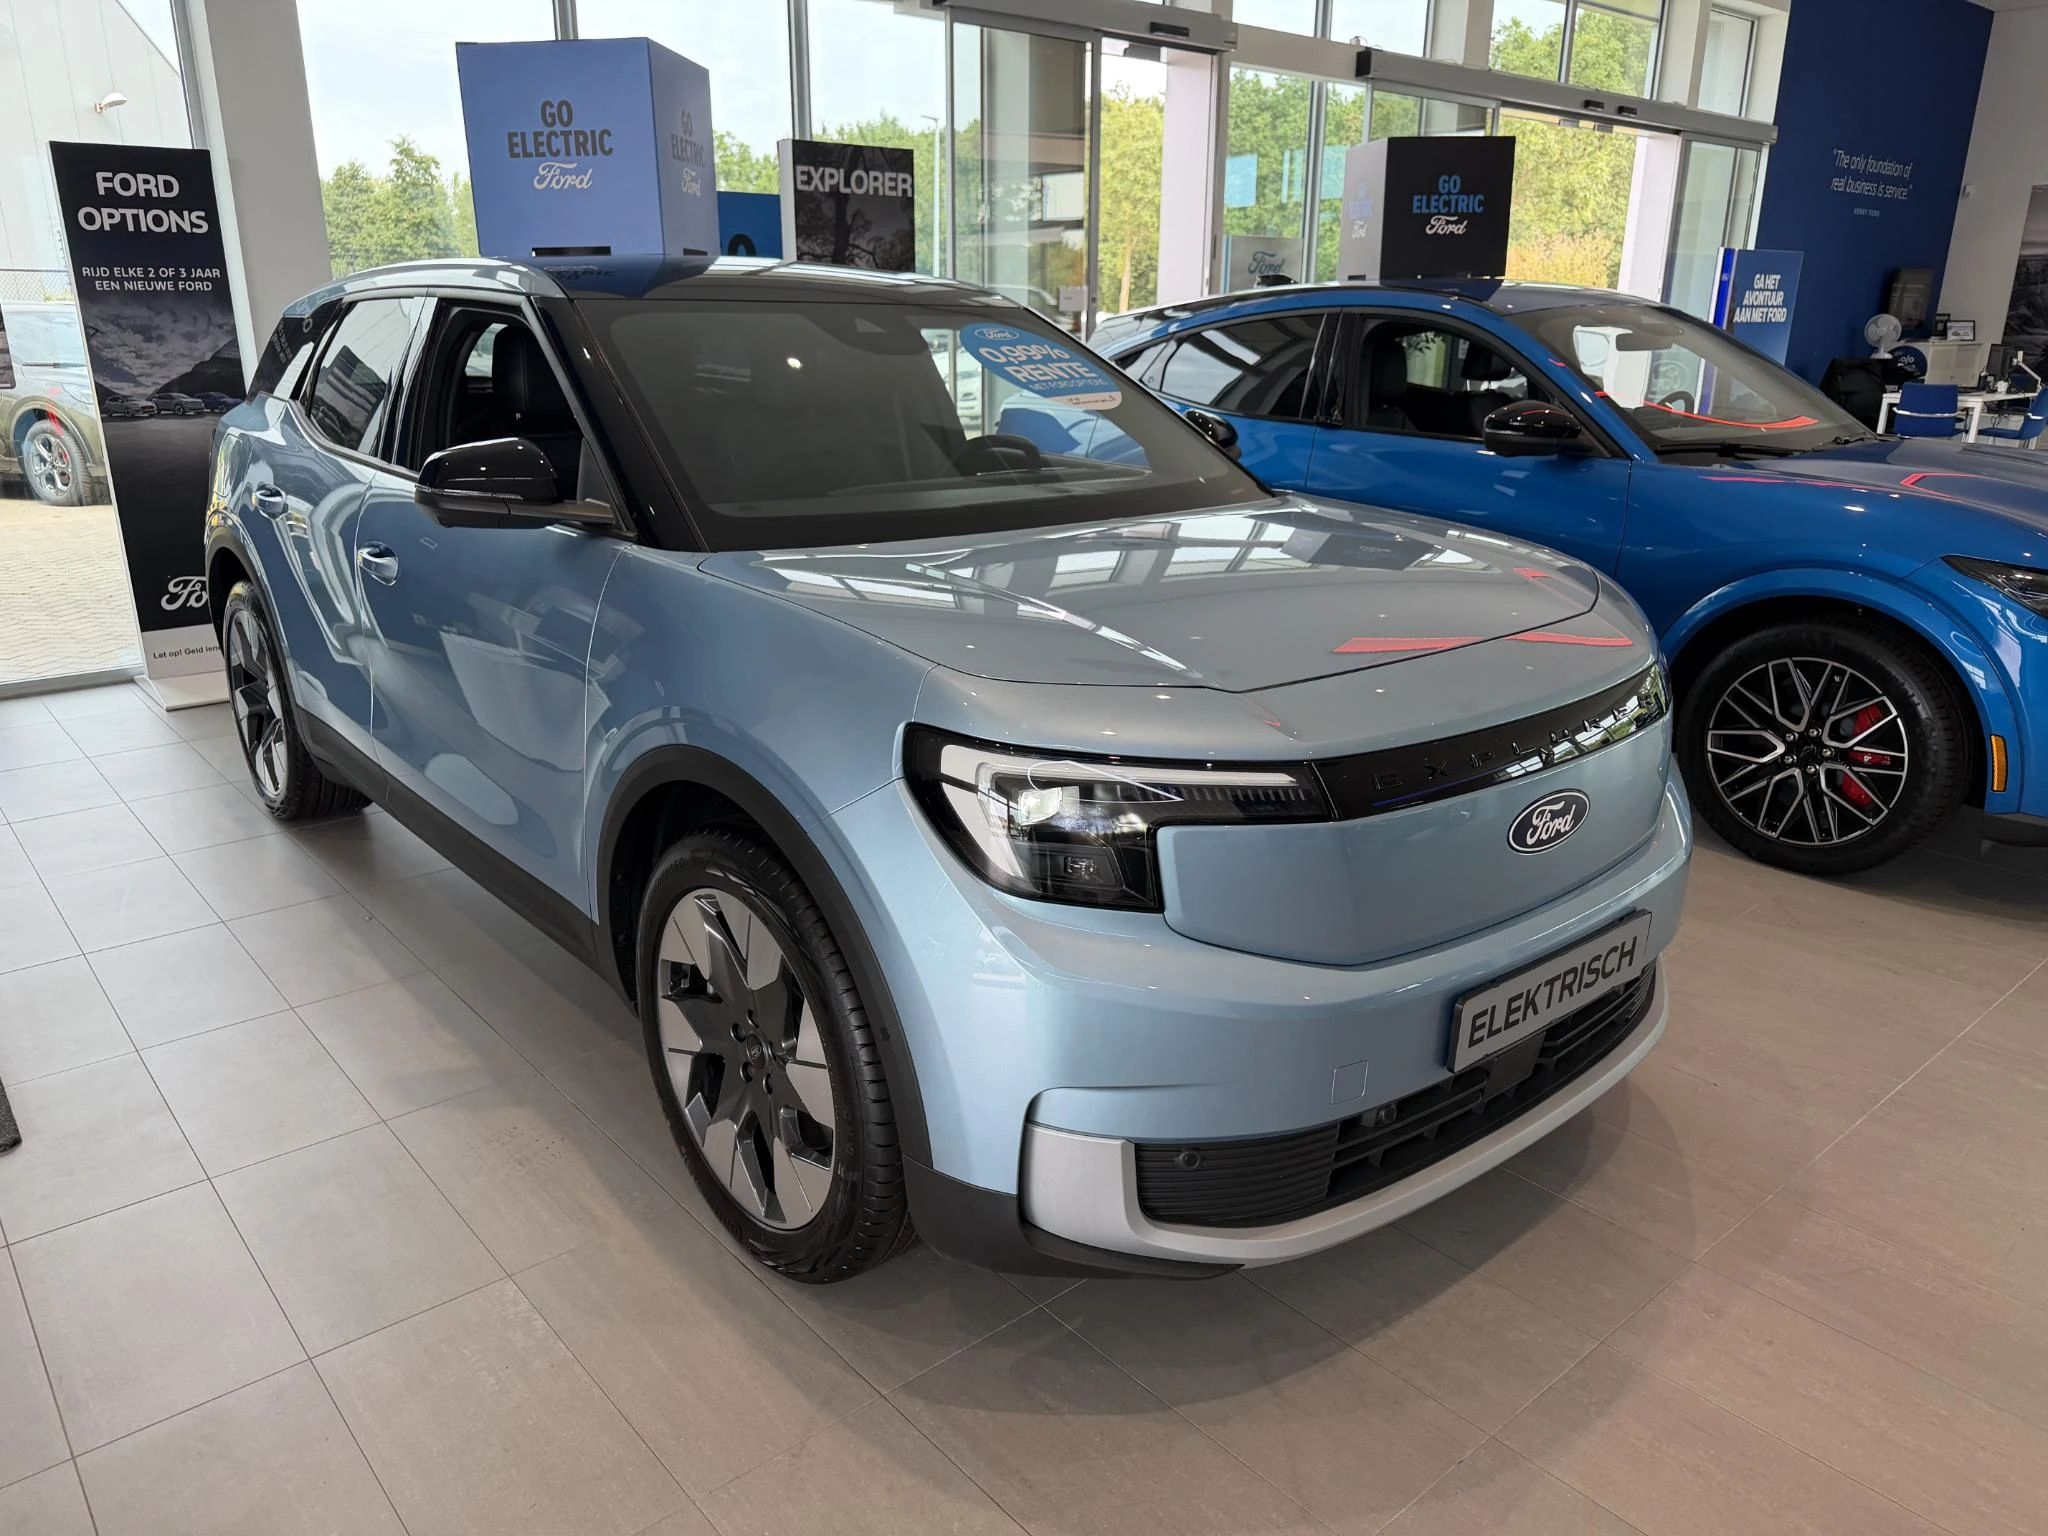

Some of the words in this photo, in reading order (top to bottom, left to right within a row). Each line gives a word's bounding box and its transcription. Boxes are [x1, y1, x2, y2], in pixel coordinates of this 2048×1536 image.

[541, 100, 573, 128] GO
[507, 128, 614, 158] ELECTRIC
[533, 162, 593, 190] Ford
[1850, 154, 1867, 174] only
[1866, 155, 1903, 177] foundation
[1903, 162, 1913, 180] of
[95, 171, 180, 198] FORD
[795, 165, 913, 197] EXPLORER
[1438, 174, 1461, 194] GO
[1831, 176, 1847, 191] real
[1846, 176, 1877, 196] business
[1412, 194, 1485, 214] ELECTRIC
[77, 206, 209, 234] OPTIONS
[1425, 215, 1468, 235] Ford
[82, 267, 110, 277] RIJD
[114, 267, 145, 278] ELKE
[147, 268, 155, 278] 2
[159, 268, 176, 278] OF
[179, 268, 187, 278] 3
[190, 268, 221, 278] JAAR
[1248, 251, 1286, 275] Ford
[95, 281, 120, 291] EEN
[124, 281, 175, 291] NIEUWE
[178, 281, 212, 291] FORD
[1753, 273, 1765, 290] GA
[1765, 274, 1781, 290] HET
[1742, 290, 1784, 306] AVONTUUR
[1733, 306, 1752, 323] AAN
[1751, 307, 1768, 323] MET
[1767, 307, 1787, 323] FORD
[978, 343, 1071, 364] 0,99%
[1003, 361, 1098, 383] RENTE
[161, 576, 208, 611] Fo
[153, 651, 167, 659] Let
[184, 645, 203, 655] Geld
[1526, 800, 1577, 846] Ford
[1467, 936, 1638, 1049] ELEKTRISCH
